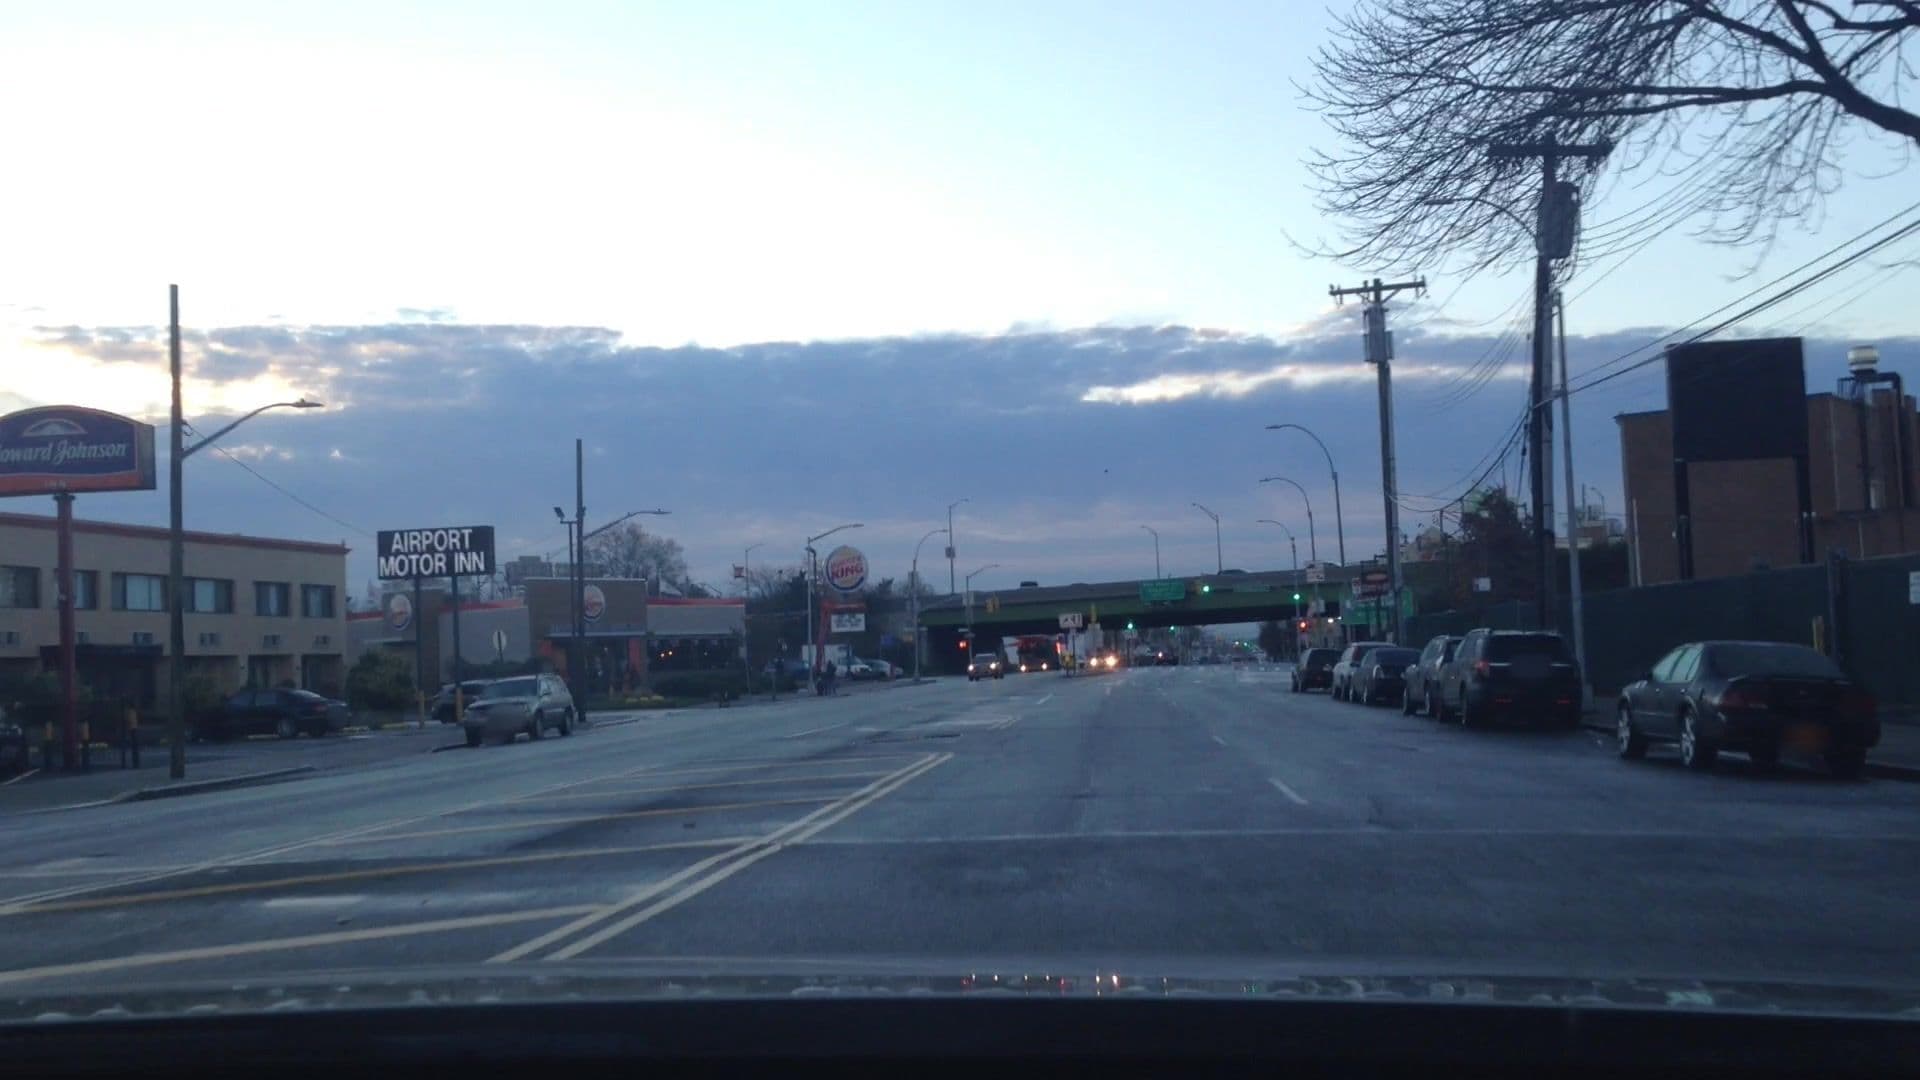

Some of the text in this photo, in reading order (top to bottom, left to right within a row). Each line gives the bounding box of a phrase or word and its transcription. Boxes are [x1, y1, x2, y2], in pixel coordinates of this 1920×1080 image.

[0, 440, 128, 465] oward Johnson
[391, 529, 472, 552] AIRPORT
[379, 552, 485, 576] MOTOR INN
